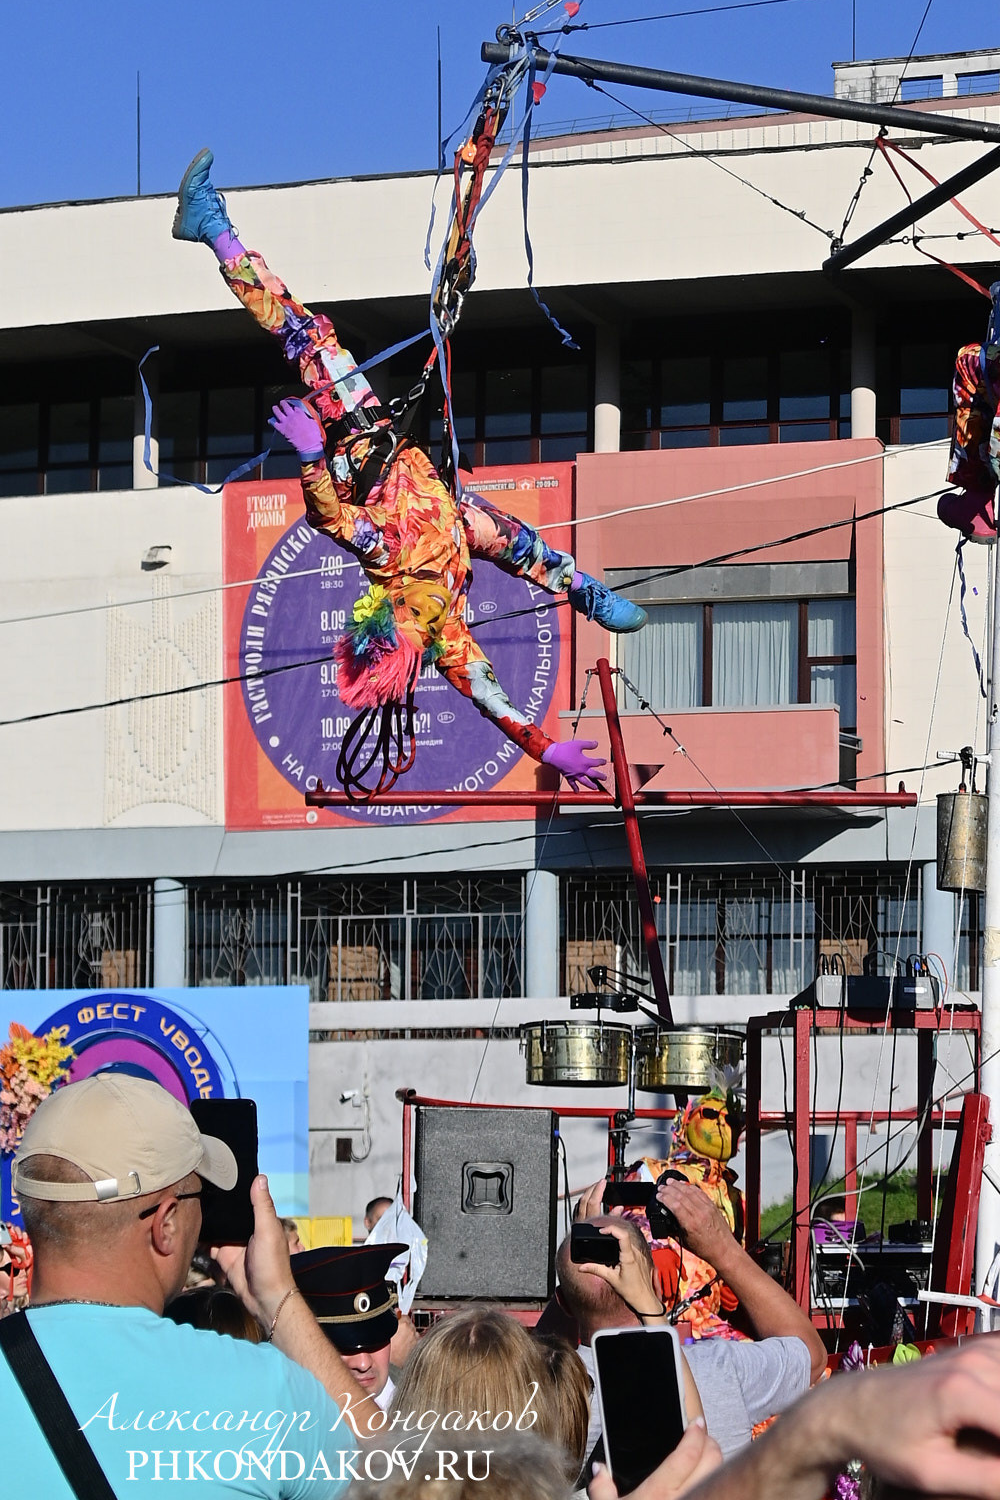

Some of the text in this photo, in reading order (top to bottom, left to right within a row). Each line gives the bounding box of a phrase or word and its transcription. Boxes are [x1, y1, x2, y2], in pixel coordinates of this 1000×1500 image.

[320, 610, 346, 631] 8.09
[245, 624, 273, 725] ГАСТРОЛИ
[320, 664, 342, 685] 9.0
[281, 753, 305, 782] НА
[77, 1002, 147, 1023] ФЕСТ
